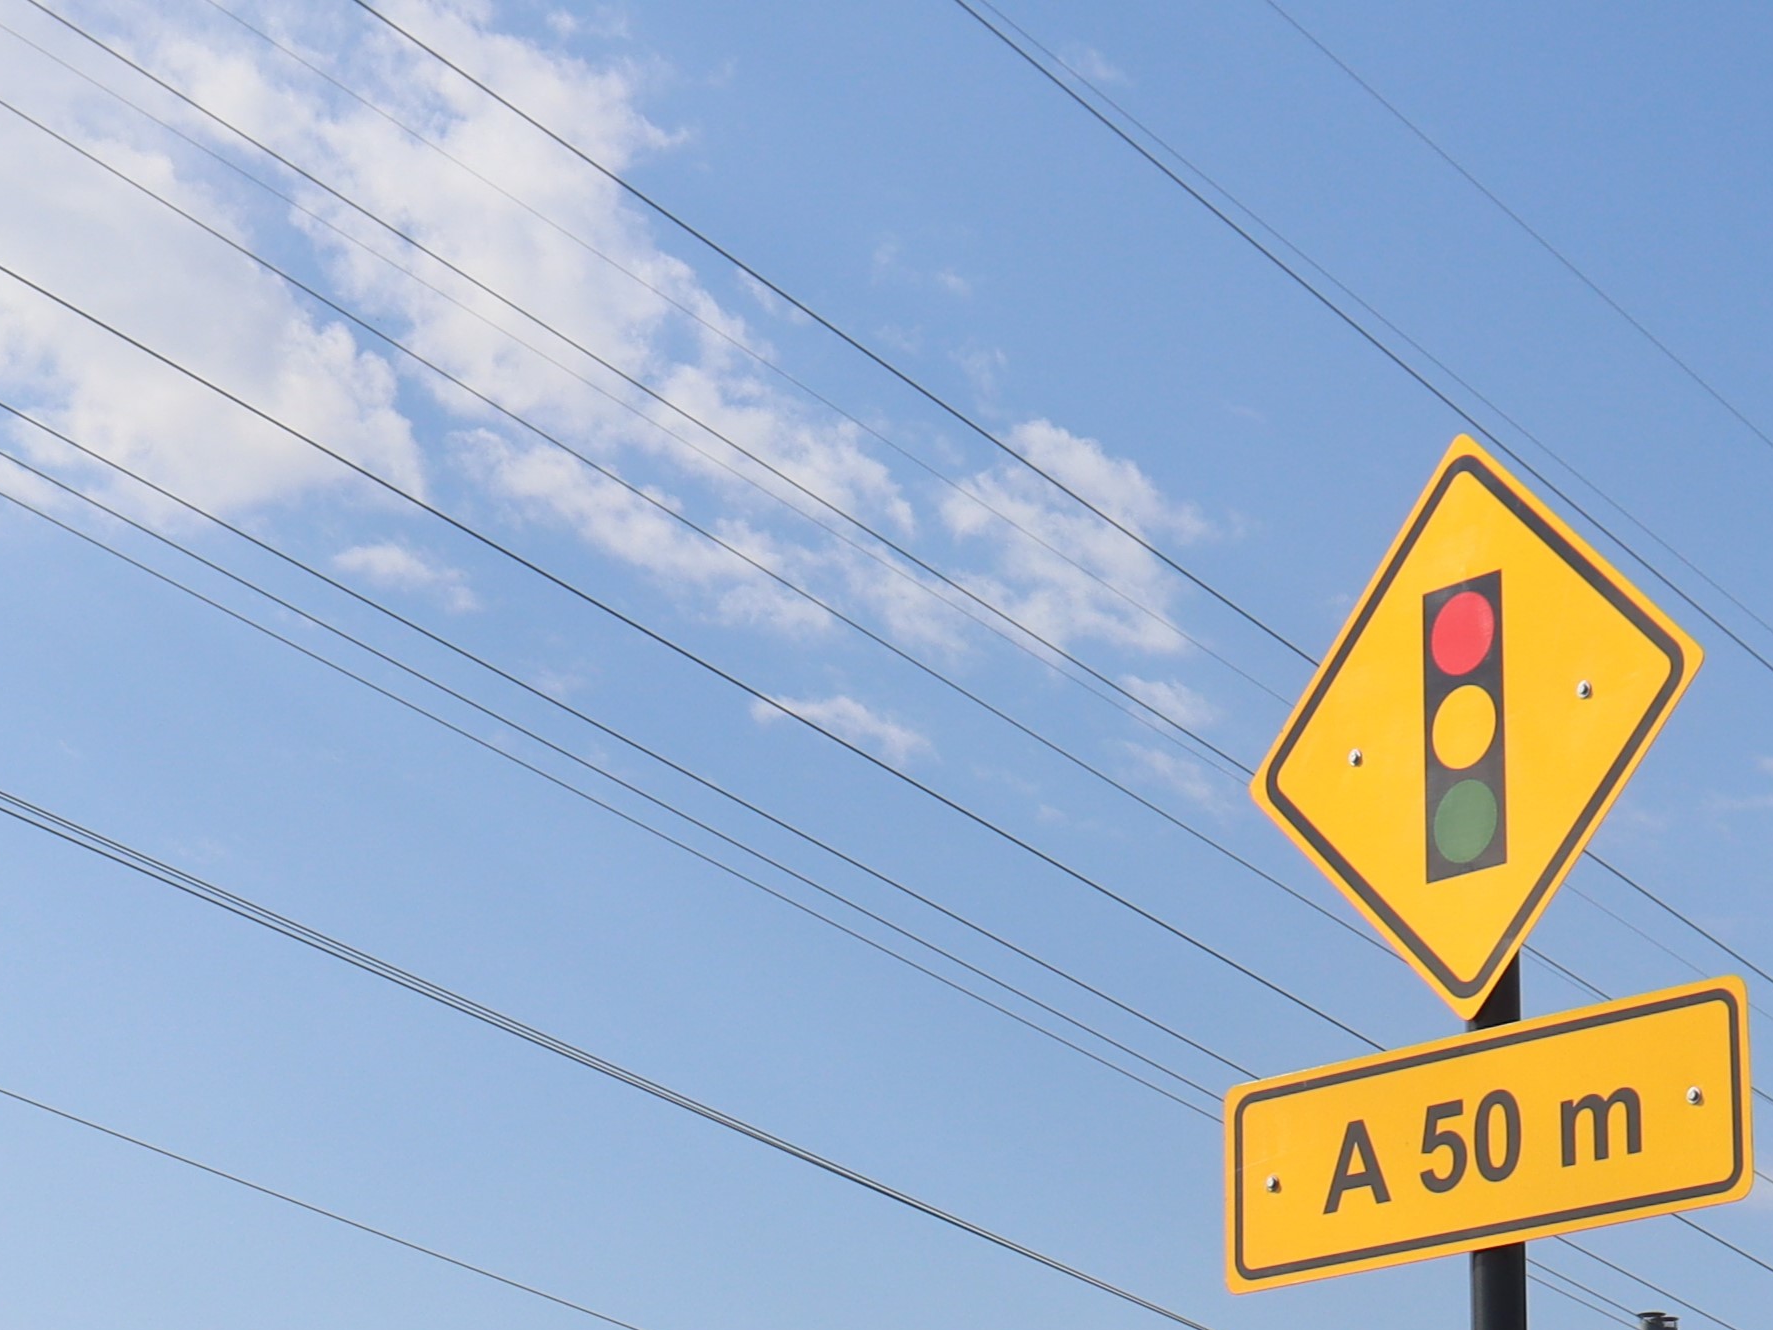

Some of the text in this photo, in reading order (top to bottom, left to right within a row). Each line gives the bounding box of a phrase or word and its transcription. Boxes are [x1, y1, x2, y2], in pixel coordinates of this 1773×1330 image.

[1324, 1088, 1641, 1214] A 50 m
